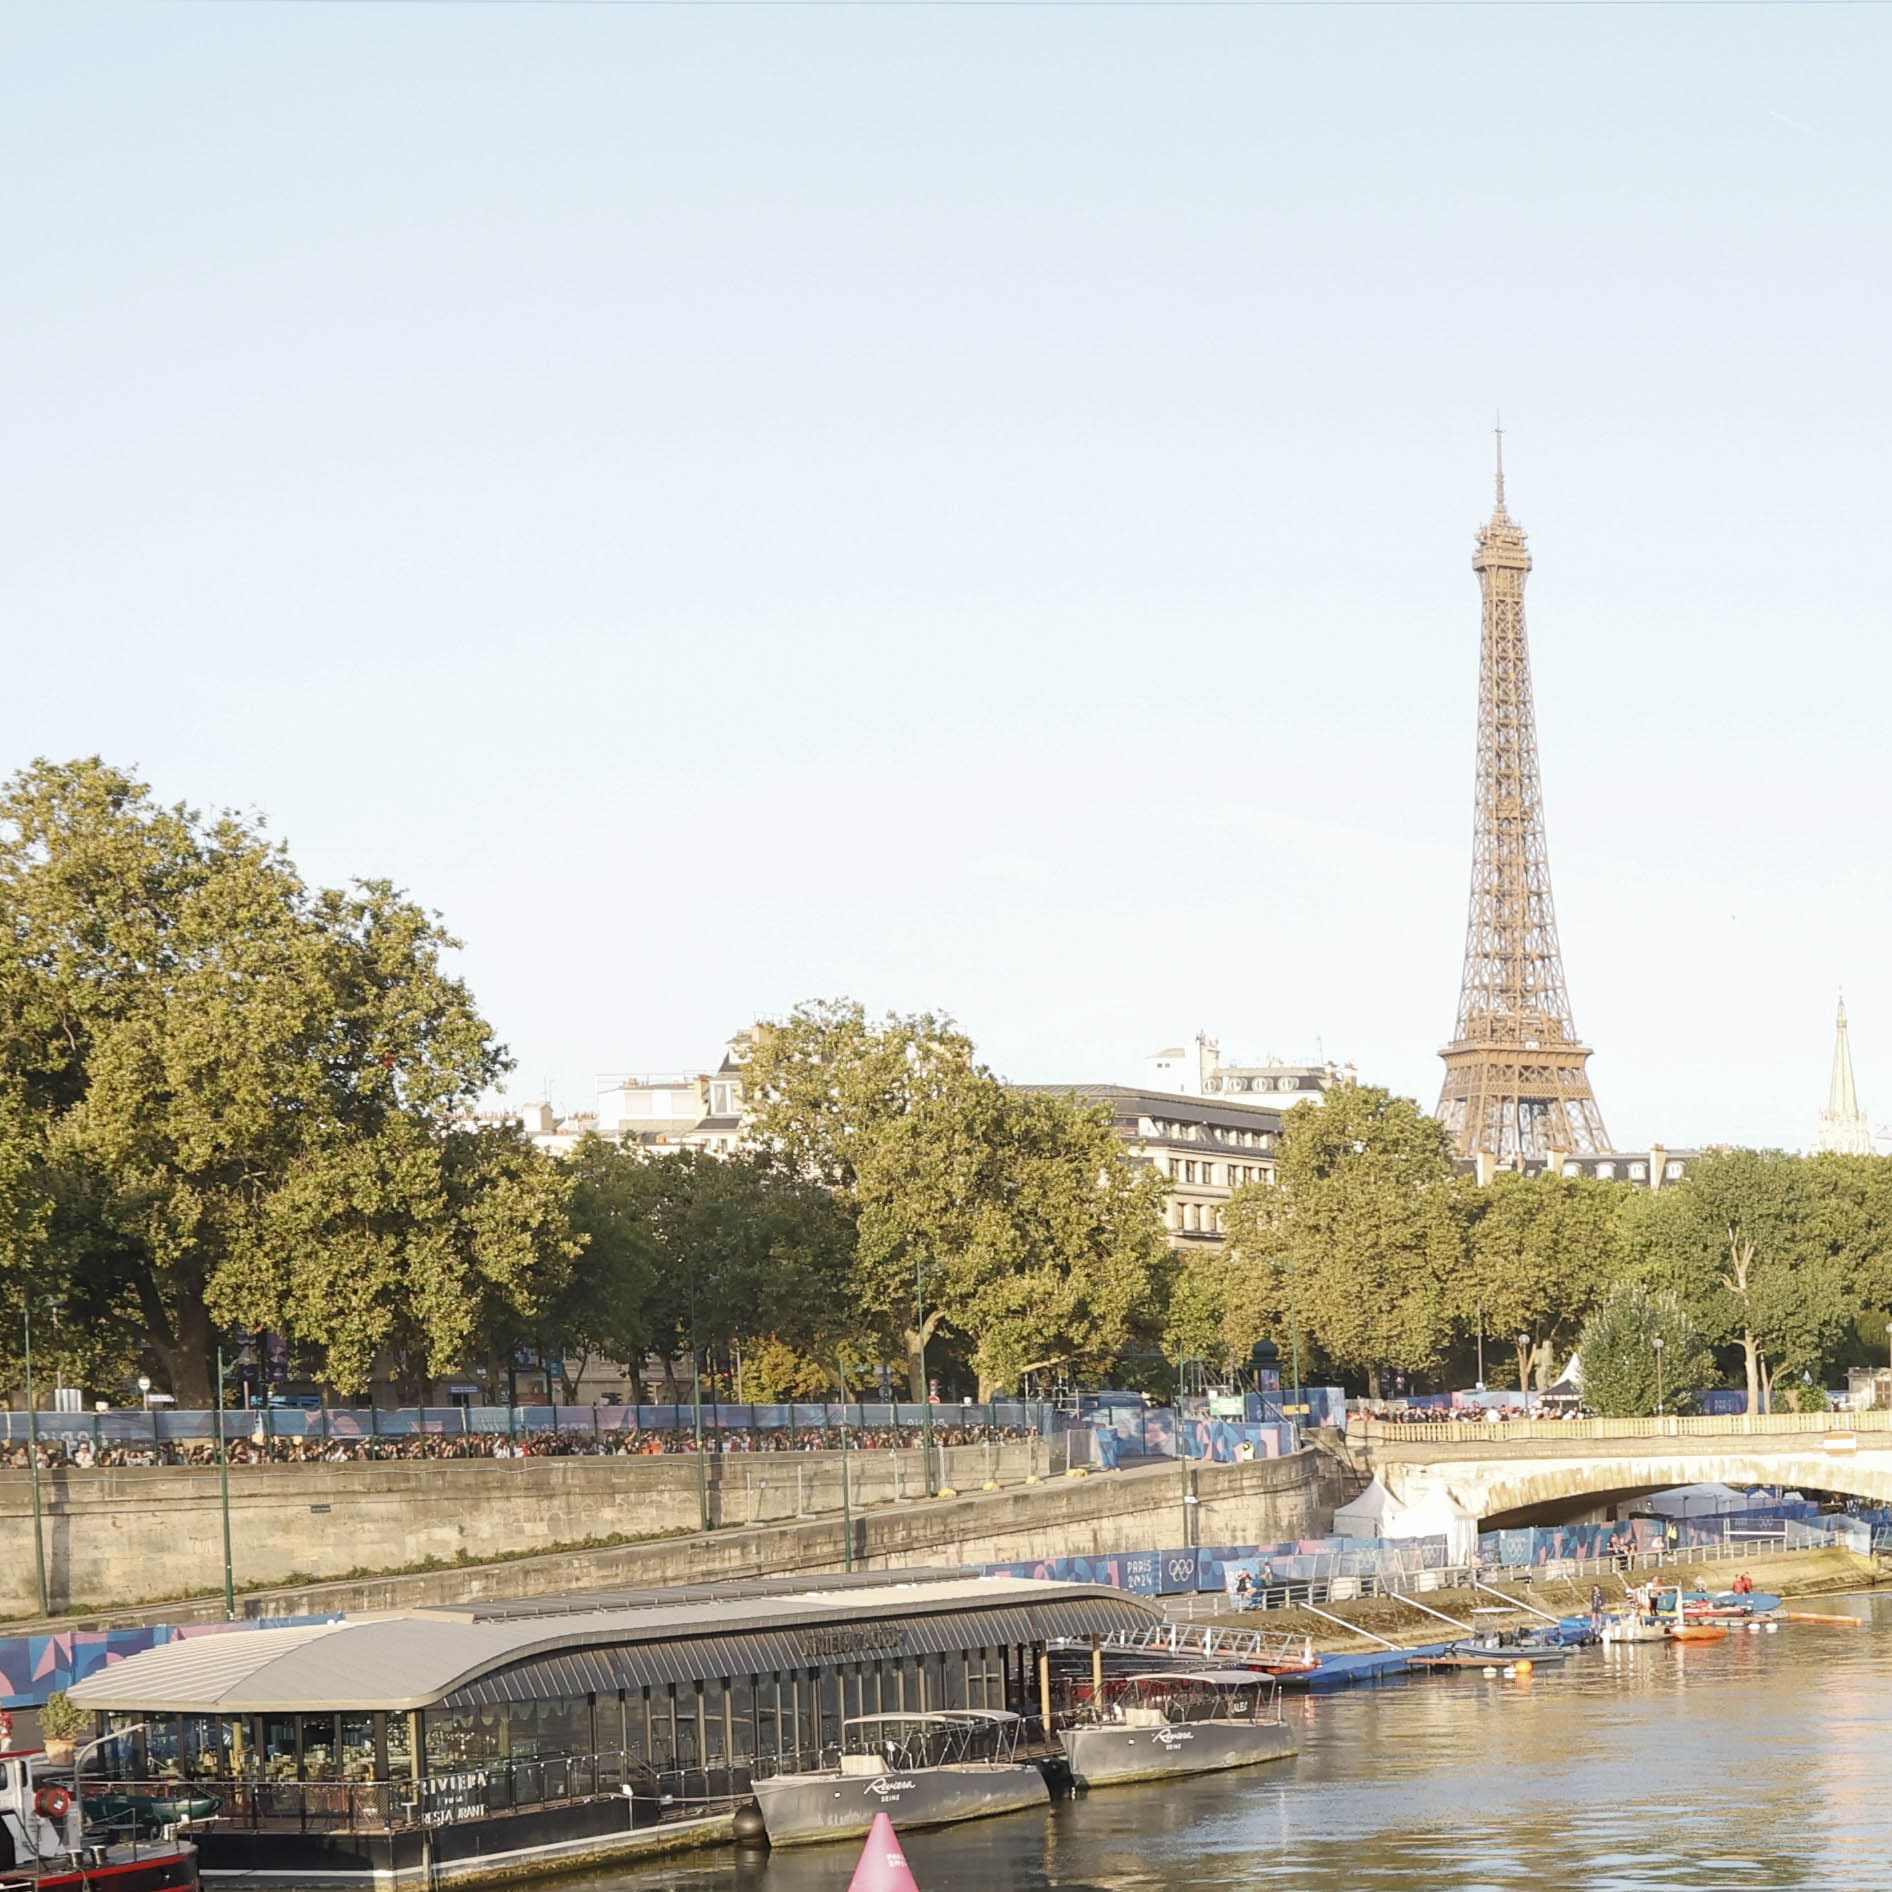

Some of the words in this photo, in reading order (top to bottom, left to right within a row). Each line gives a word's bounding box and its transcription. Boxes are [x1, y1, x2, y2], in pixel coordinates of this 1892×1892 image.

[1127, 1574, 1152, 1588] 2024
[863, 1777, 916, 1795] Riviera
[421, 1803, 486, 1826] RESTARANT
